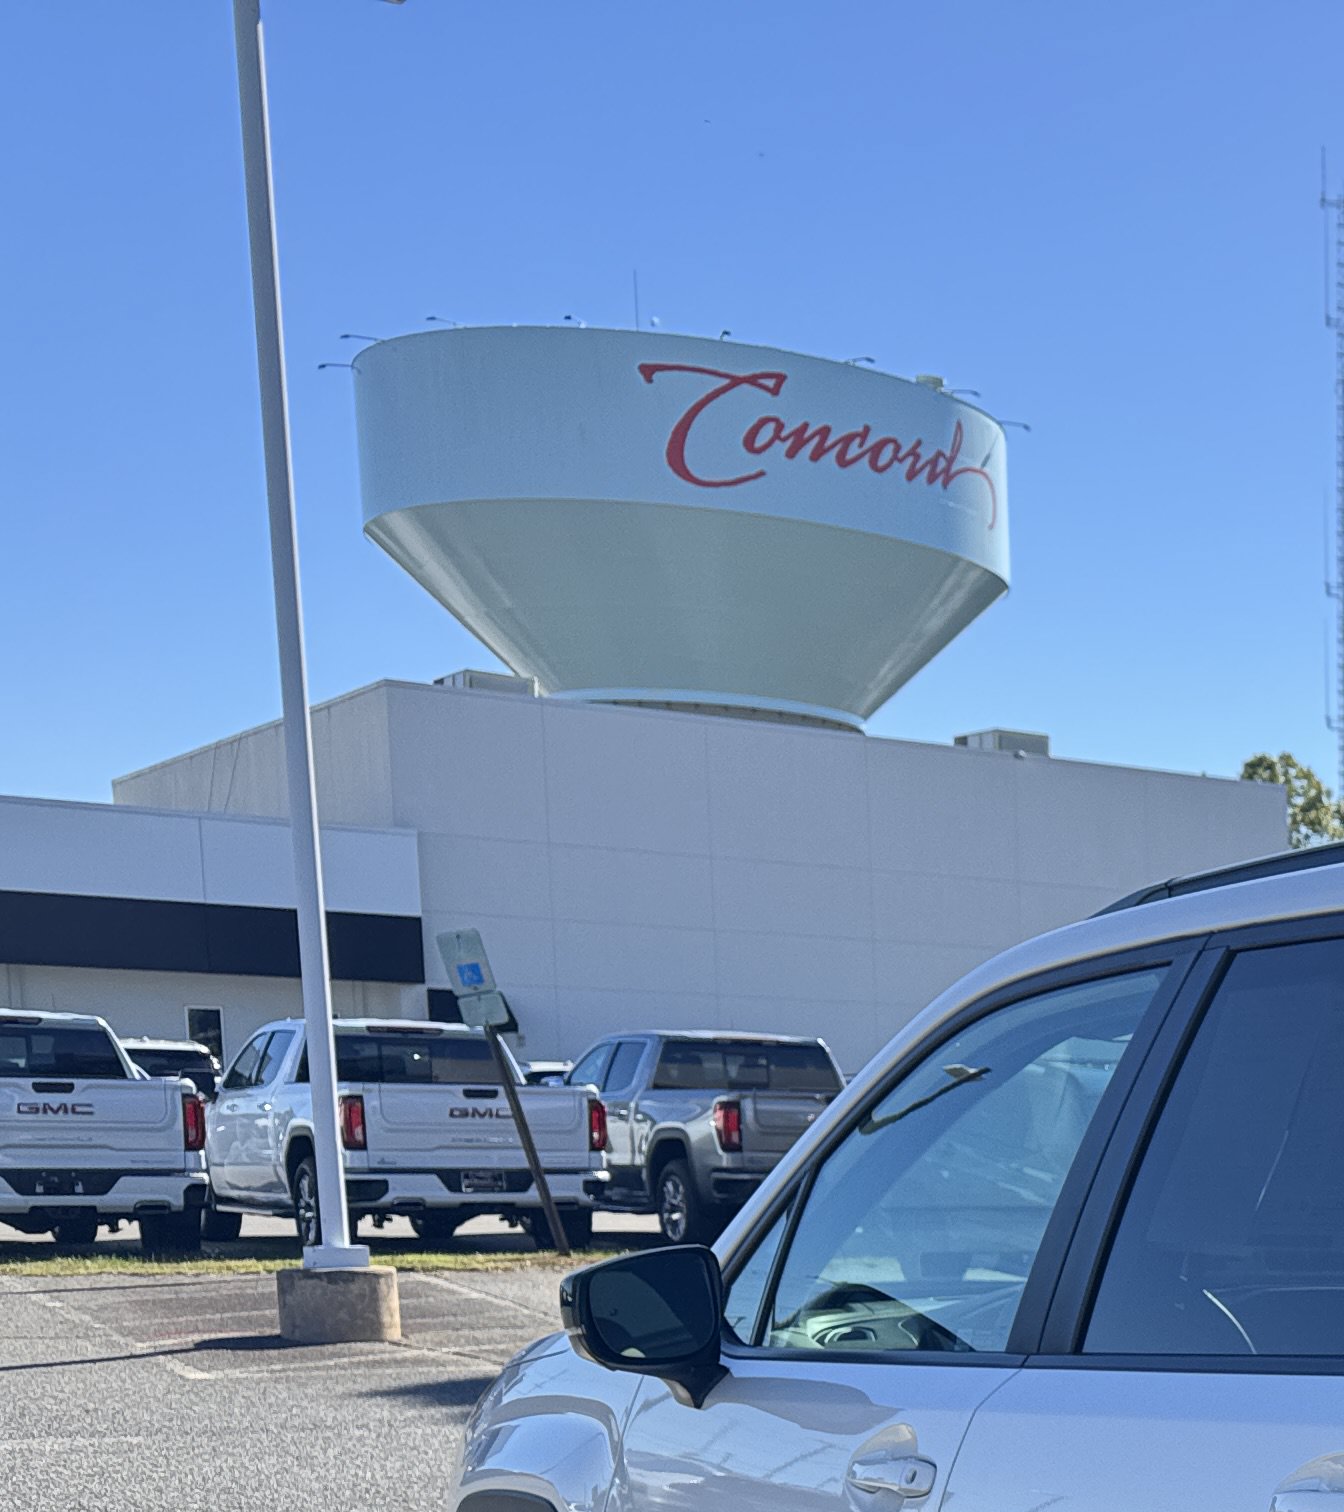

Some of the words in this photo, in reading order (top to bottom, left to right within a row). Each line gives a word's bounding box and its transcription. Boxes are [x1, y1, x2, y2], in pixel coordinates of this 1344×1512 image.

[638, 362, 997, 531] Concord
[16, 1102, 95, 1115] GMC
[448, 1107, 515, 1119] GMC
